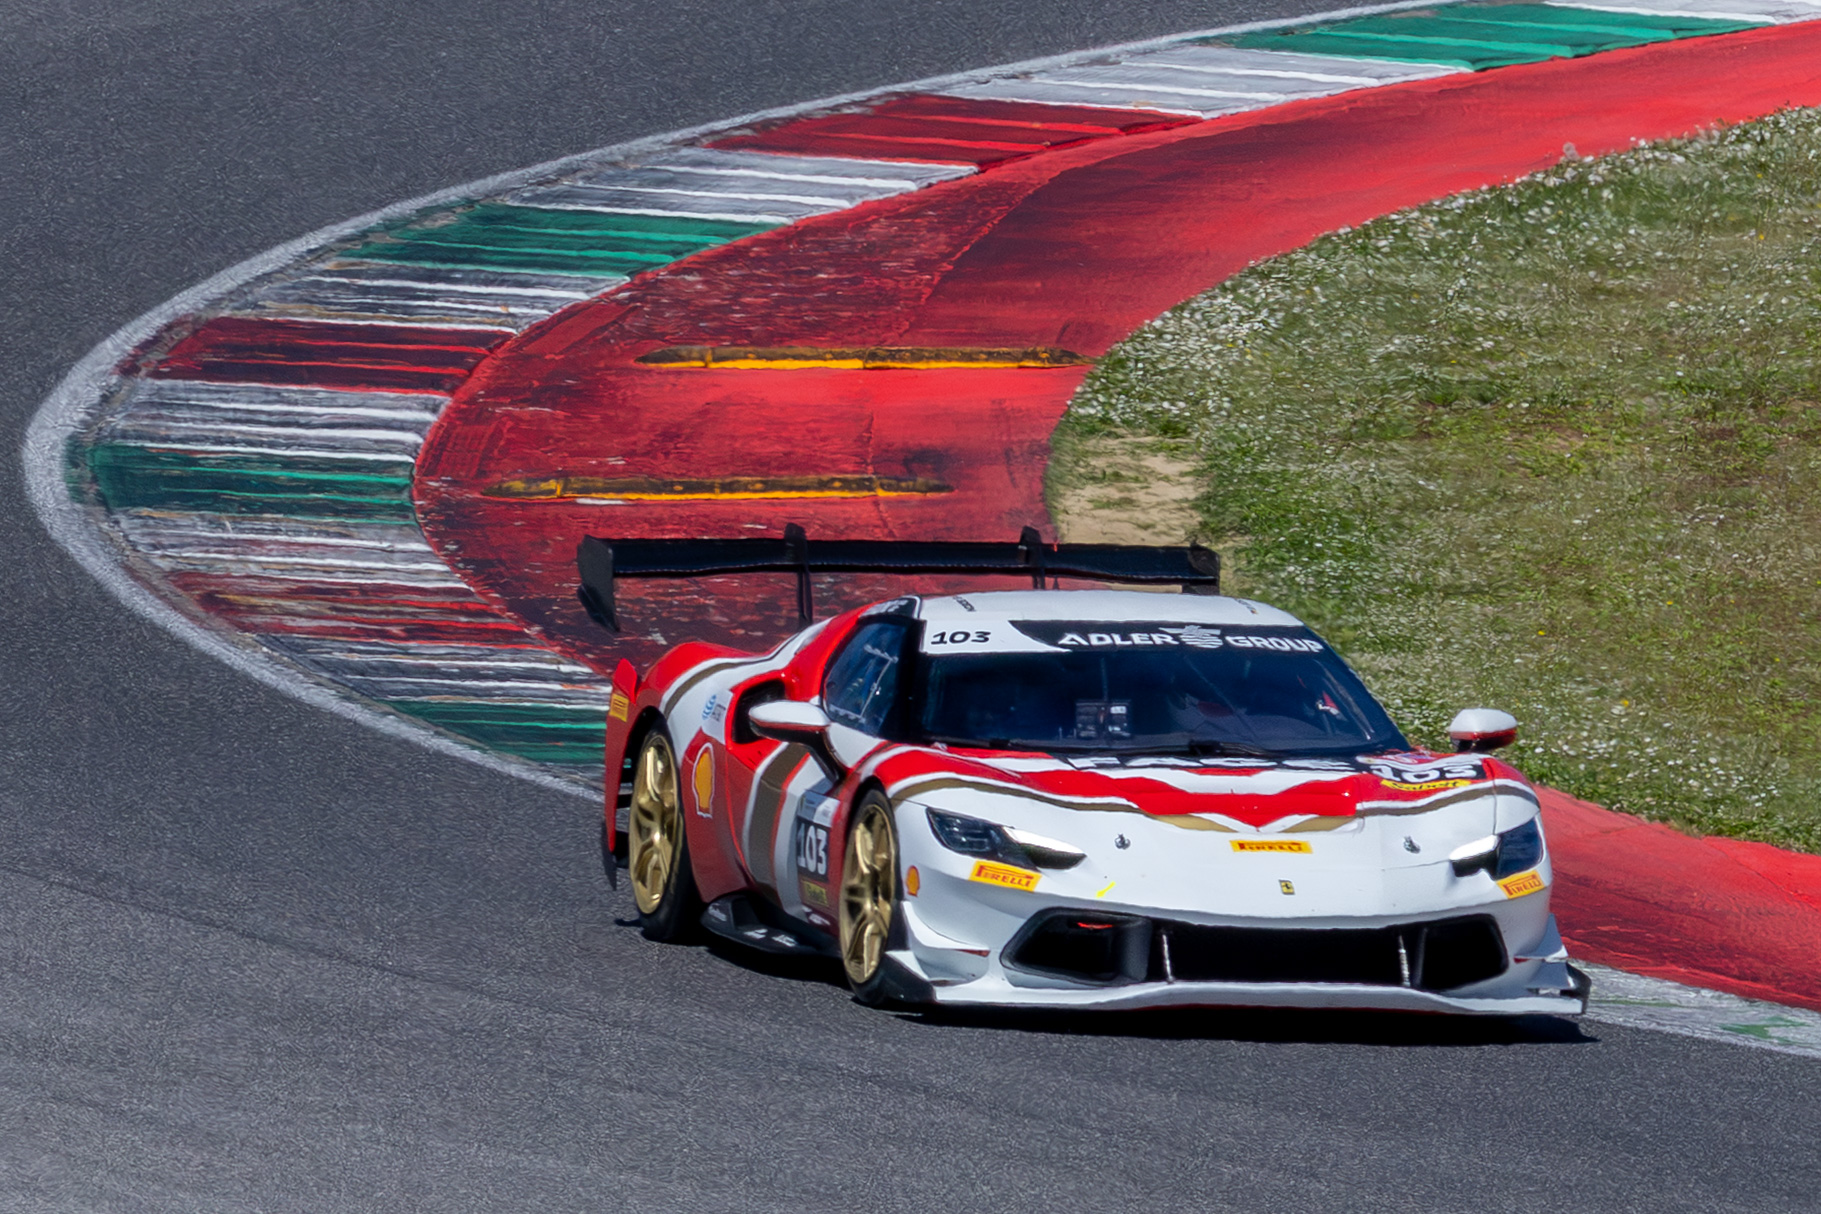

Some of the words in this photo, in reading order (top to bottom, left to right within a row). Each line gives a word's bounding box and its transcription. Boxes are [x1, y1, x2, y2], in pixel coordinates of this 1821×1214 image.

[931, 631, 991, 645] 103
[1057, 633, 1179, 646] ADLER
[1225, 635, 1324, 653] GROUP
[1370, 764, 1477, 783] 103
[798, 822, 828, 875] 103
[1237, 842, 1303, 852] PIRELLI
[975, 865, 1034, 888] PIRELLI
[1502, 873, 1542, 896] PIRELLI
